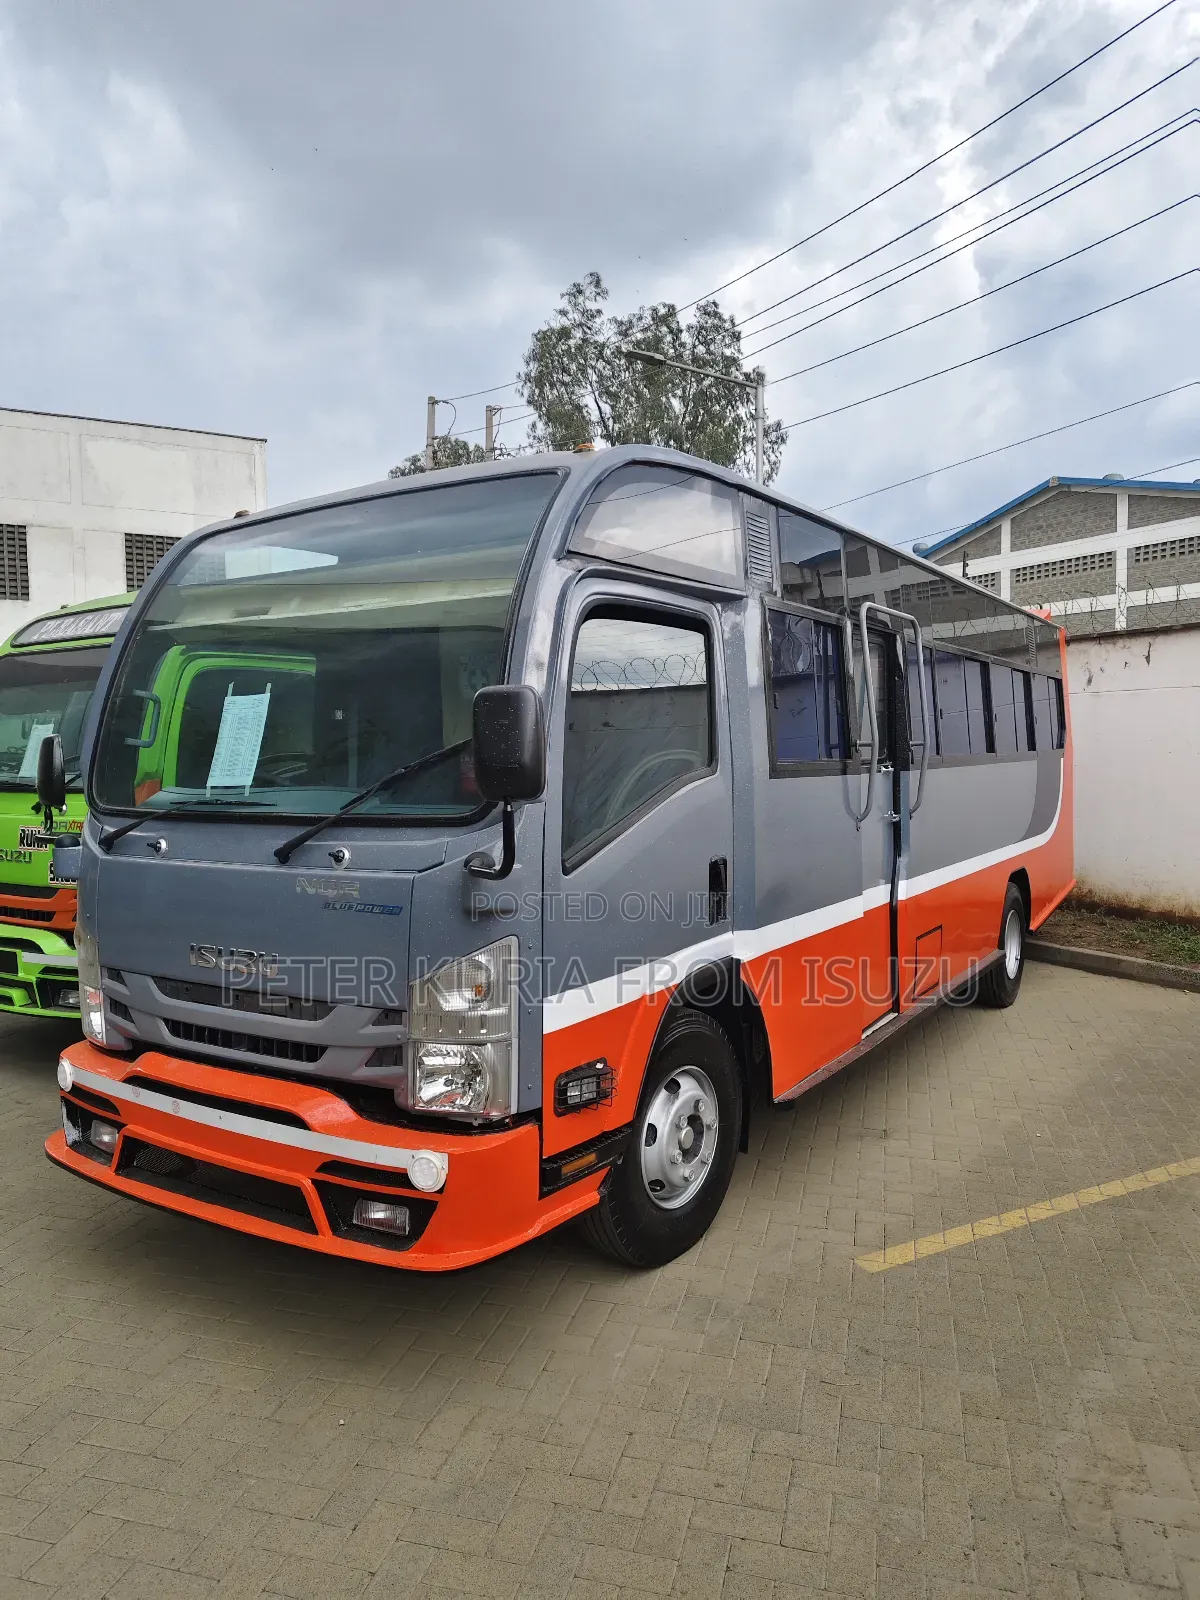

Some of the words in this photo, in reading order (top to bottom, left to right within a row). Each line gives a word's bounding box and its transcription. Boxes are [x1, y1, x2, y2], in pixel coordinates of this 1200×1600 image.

[0, 848, 33, 864] SUZU
[296, 877, 360, 898] NQR
[189, 942, 279, 977] ISUZU
